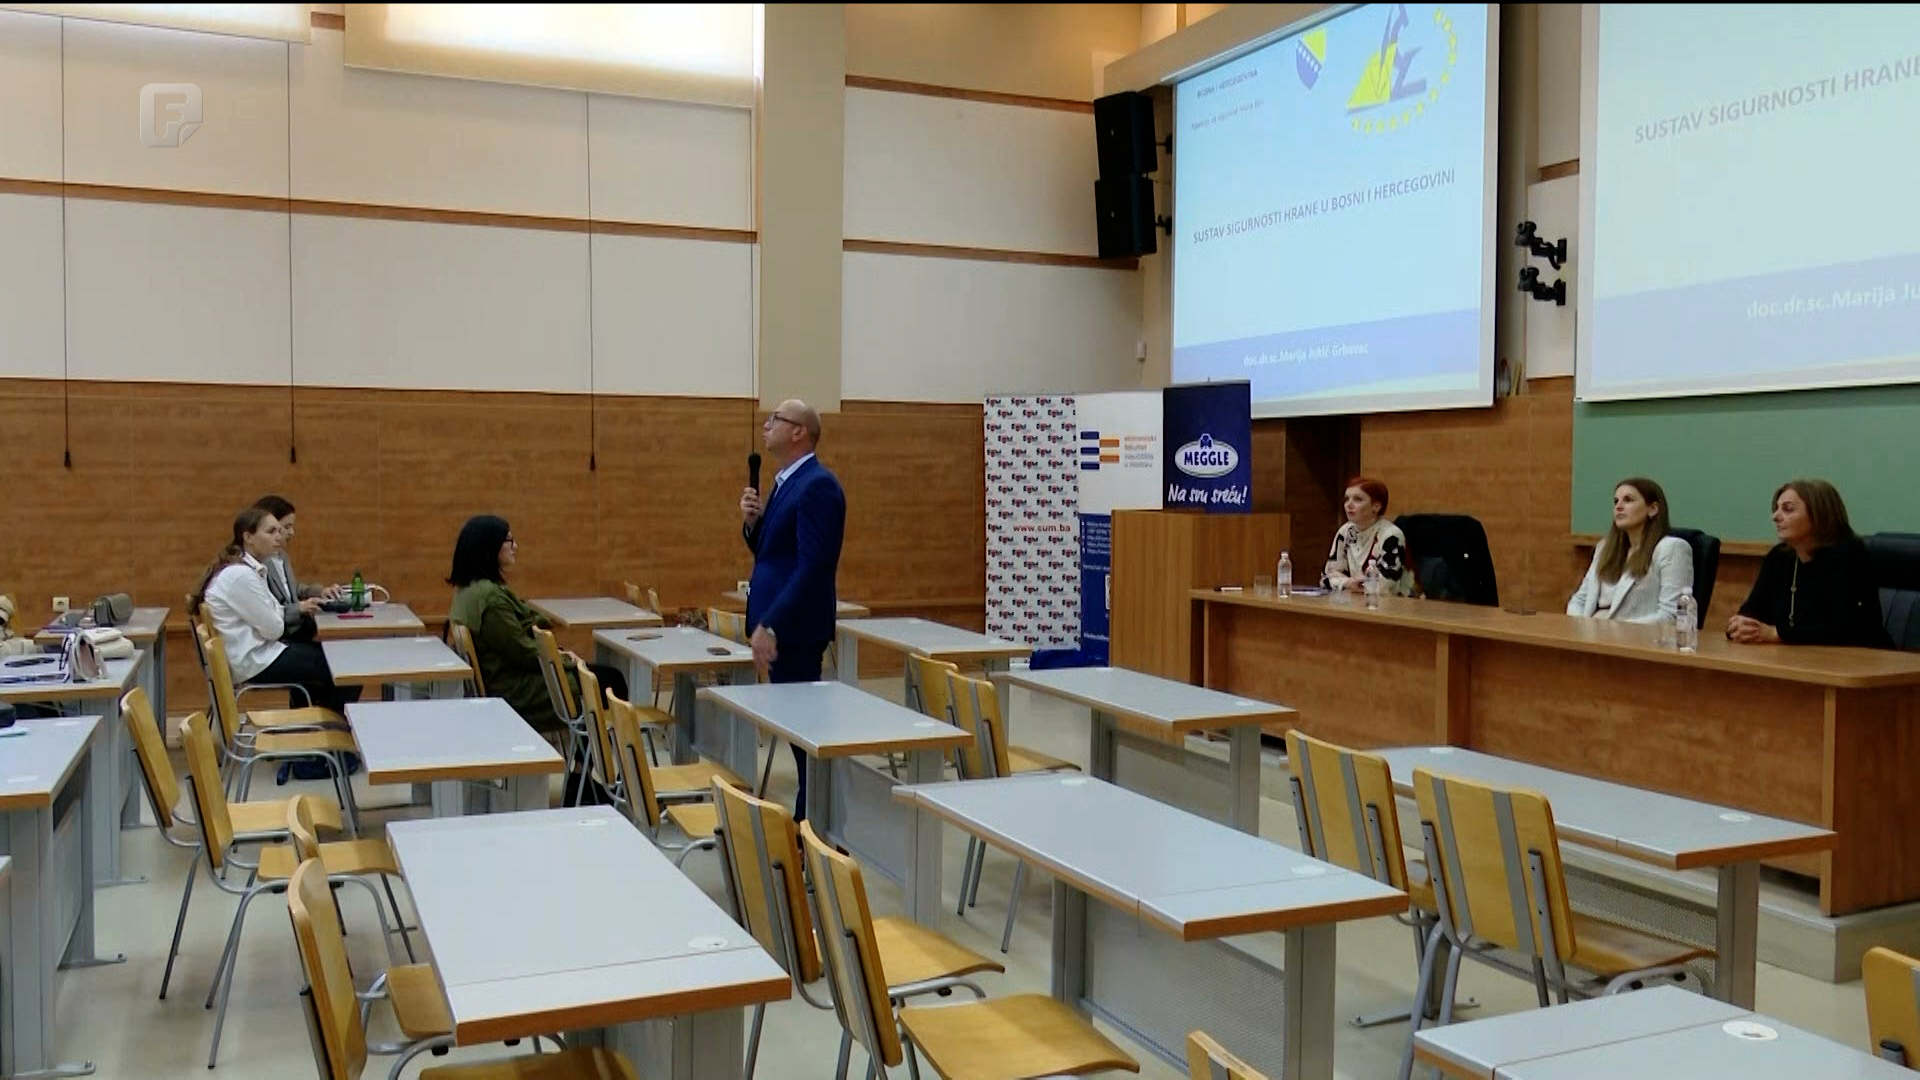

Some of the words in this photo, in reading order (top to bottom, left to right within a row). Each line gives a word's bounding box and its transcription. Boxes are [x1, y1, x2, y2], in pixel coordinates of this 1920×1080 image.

[1634, 110, 1704, 144] SUSTAV
[1708, 77, 1836, 126] SIGURNOSTI
[1843, 54, 1920, 92] HRANE
[1193, 225, 1225, 244] SUSTAV
[1227, 211, 1282, 236] SIGURNOSTI
[1284, 200, 1319, 222] HRANE
[1321, 199, 1329, 213] U
[1331, 191, 1365, 212] BOSNI
[1374, 168, 1456, 201] HERCEGOVINI
[1184, 451, 1229, 466] MEGGLE
[1168, 483, 1187, 502] Na
[1189, 487, 1208, 503] svu
[1211, 485, 1248, 505] sreću!
